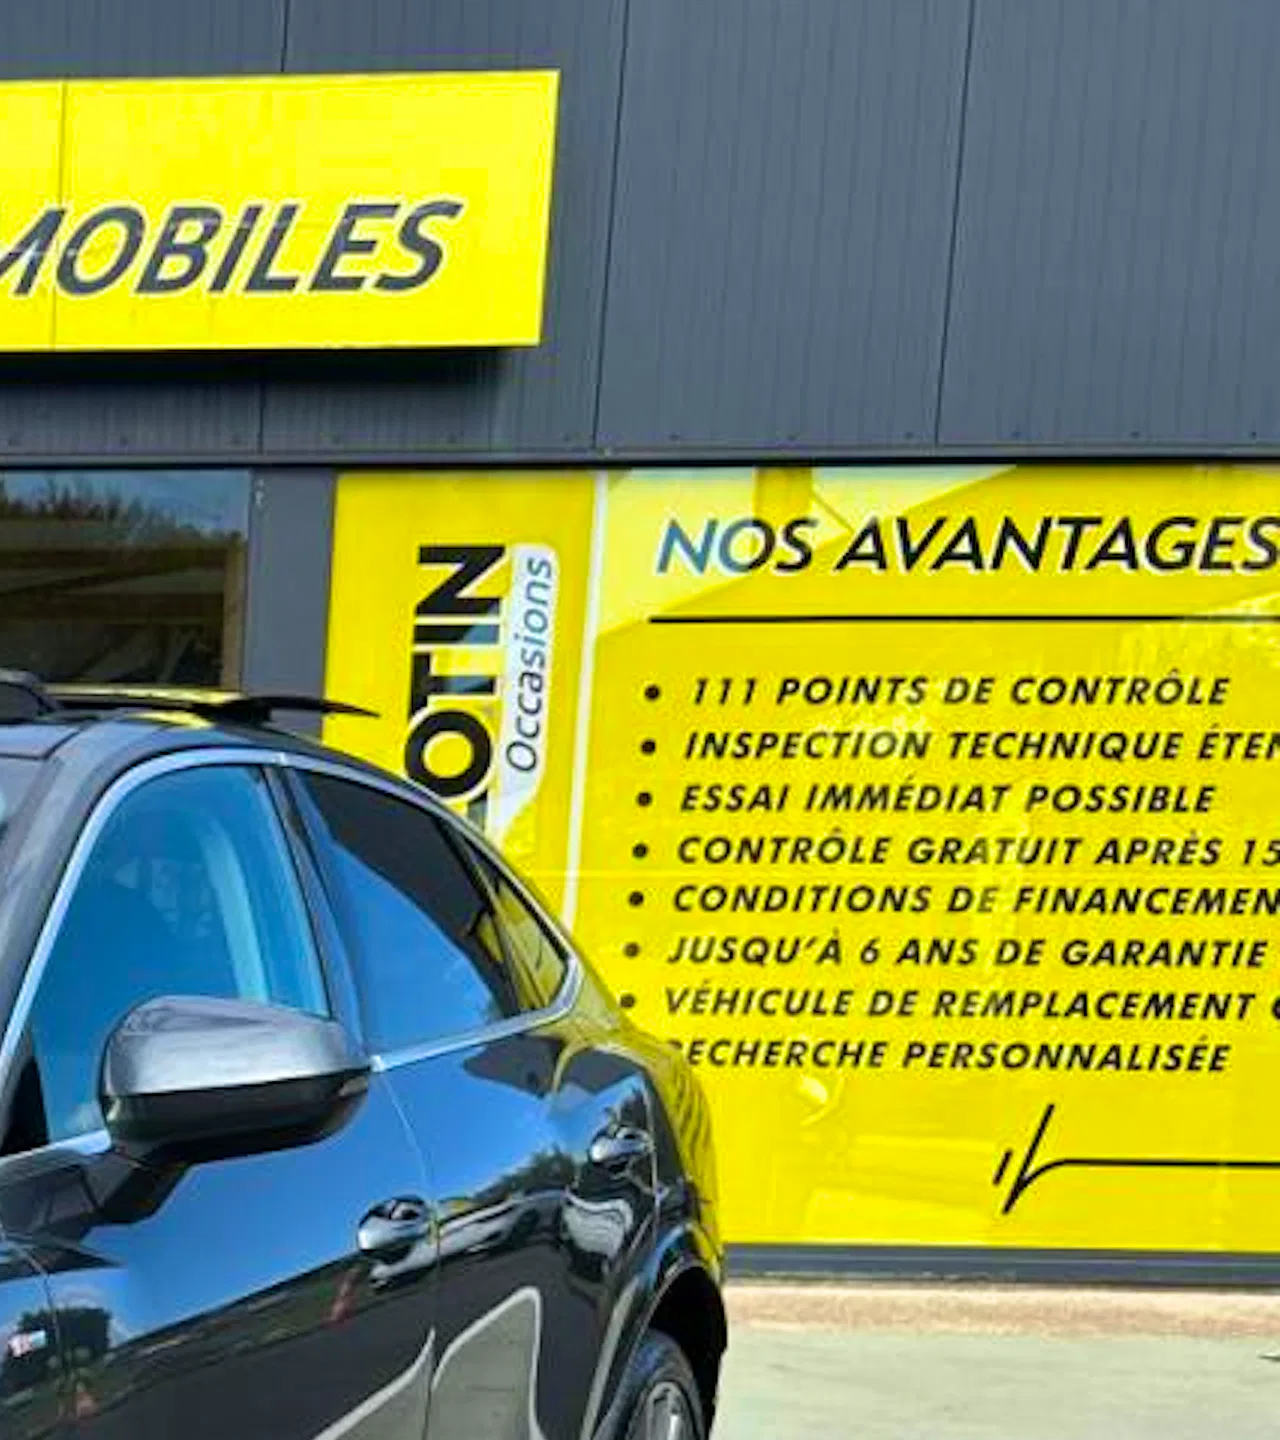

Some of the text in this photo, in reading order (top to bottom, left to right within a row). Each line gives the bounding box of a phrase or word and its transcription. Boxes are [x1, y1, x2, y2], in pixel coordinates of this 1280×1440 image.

[655, 516, 1280, 574] NOS AVANTAGES
[506, 556, 553, 772] Occasions
[403, 544, 506, 830] OTIN
[694, 668, 1231, 705] 111 POINTS DE CONTRÔLE
[684, 731, 931, 760] INSPECTION
[949, 731, 1184, 763] TECHNIQUE
[680, 775, 1217, 814] ESSAI IMMÉDIAT POSSIBLE
[677, 827, 1280, 867] CONTRÔLE GRATUIT APRÈS 15
[673, 884, 932, 913] CONDITIONS
[947, 886, 1000, 914] DE
[859, 937, 880, 965] 6
[895, 938, 979, 966] ANS
[995, 938, 1046, 966] DE
[1061, 939, 1268, 969] GARANTIE
[665, 980, 854, 1017] VÉHICULE
[867, 989, 920, 1017] DE
[932, 990, 1257, 1021] REMPLACEMENT
[902, 1035, 1231, 1072] PERSONNALISÉE
